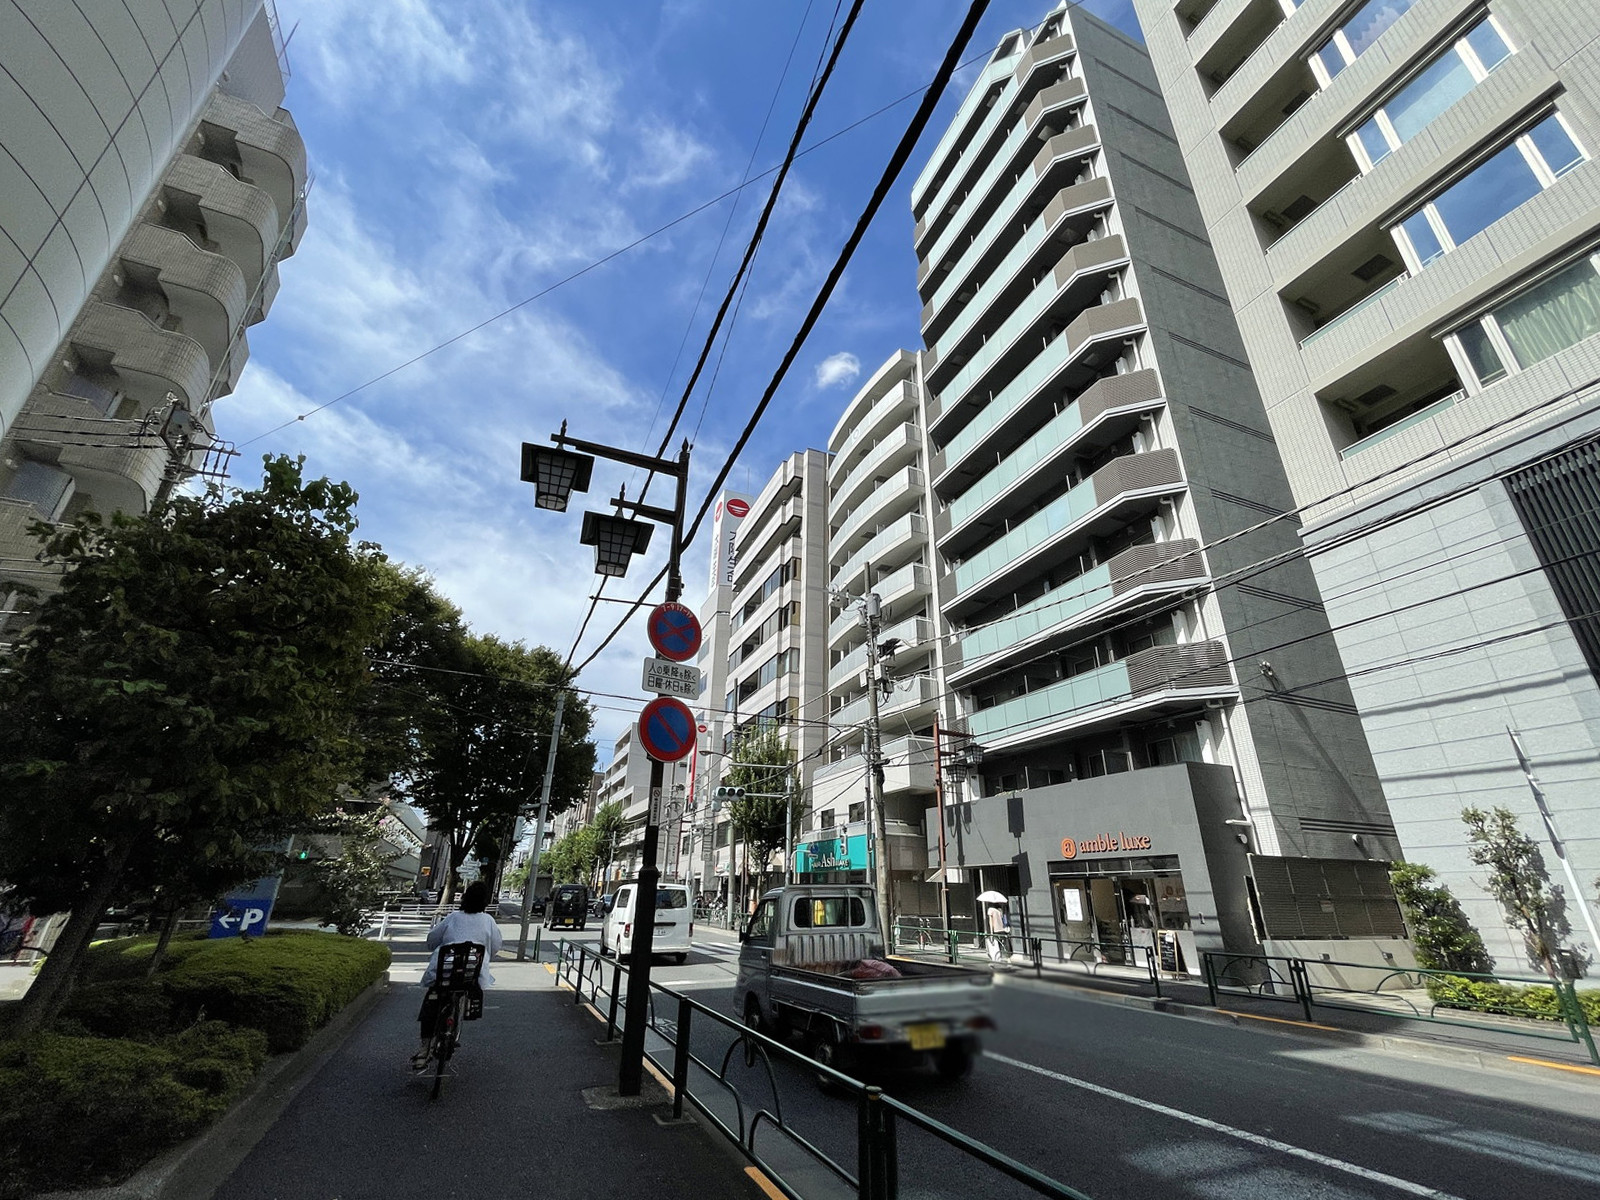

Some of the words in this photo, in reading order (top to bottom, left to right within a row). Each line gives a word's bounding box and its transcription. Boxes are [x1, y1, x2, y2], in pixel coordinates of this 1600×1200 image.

[648, 662, 696, 682] 人の乗降を除く
[1080, 833, 1119, 853] amble
[1119, 831, 1151, 851] luxe
[240, 908, 264, 931] P
